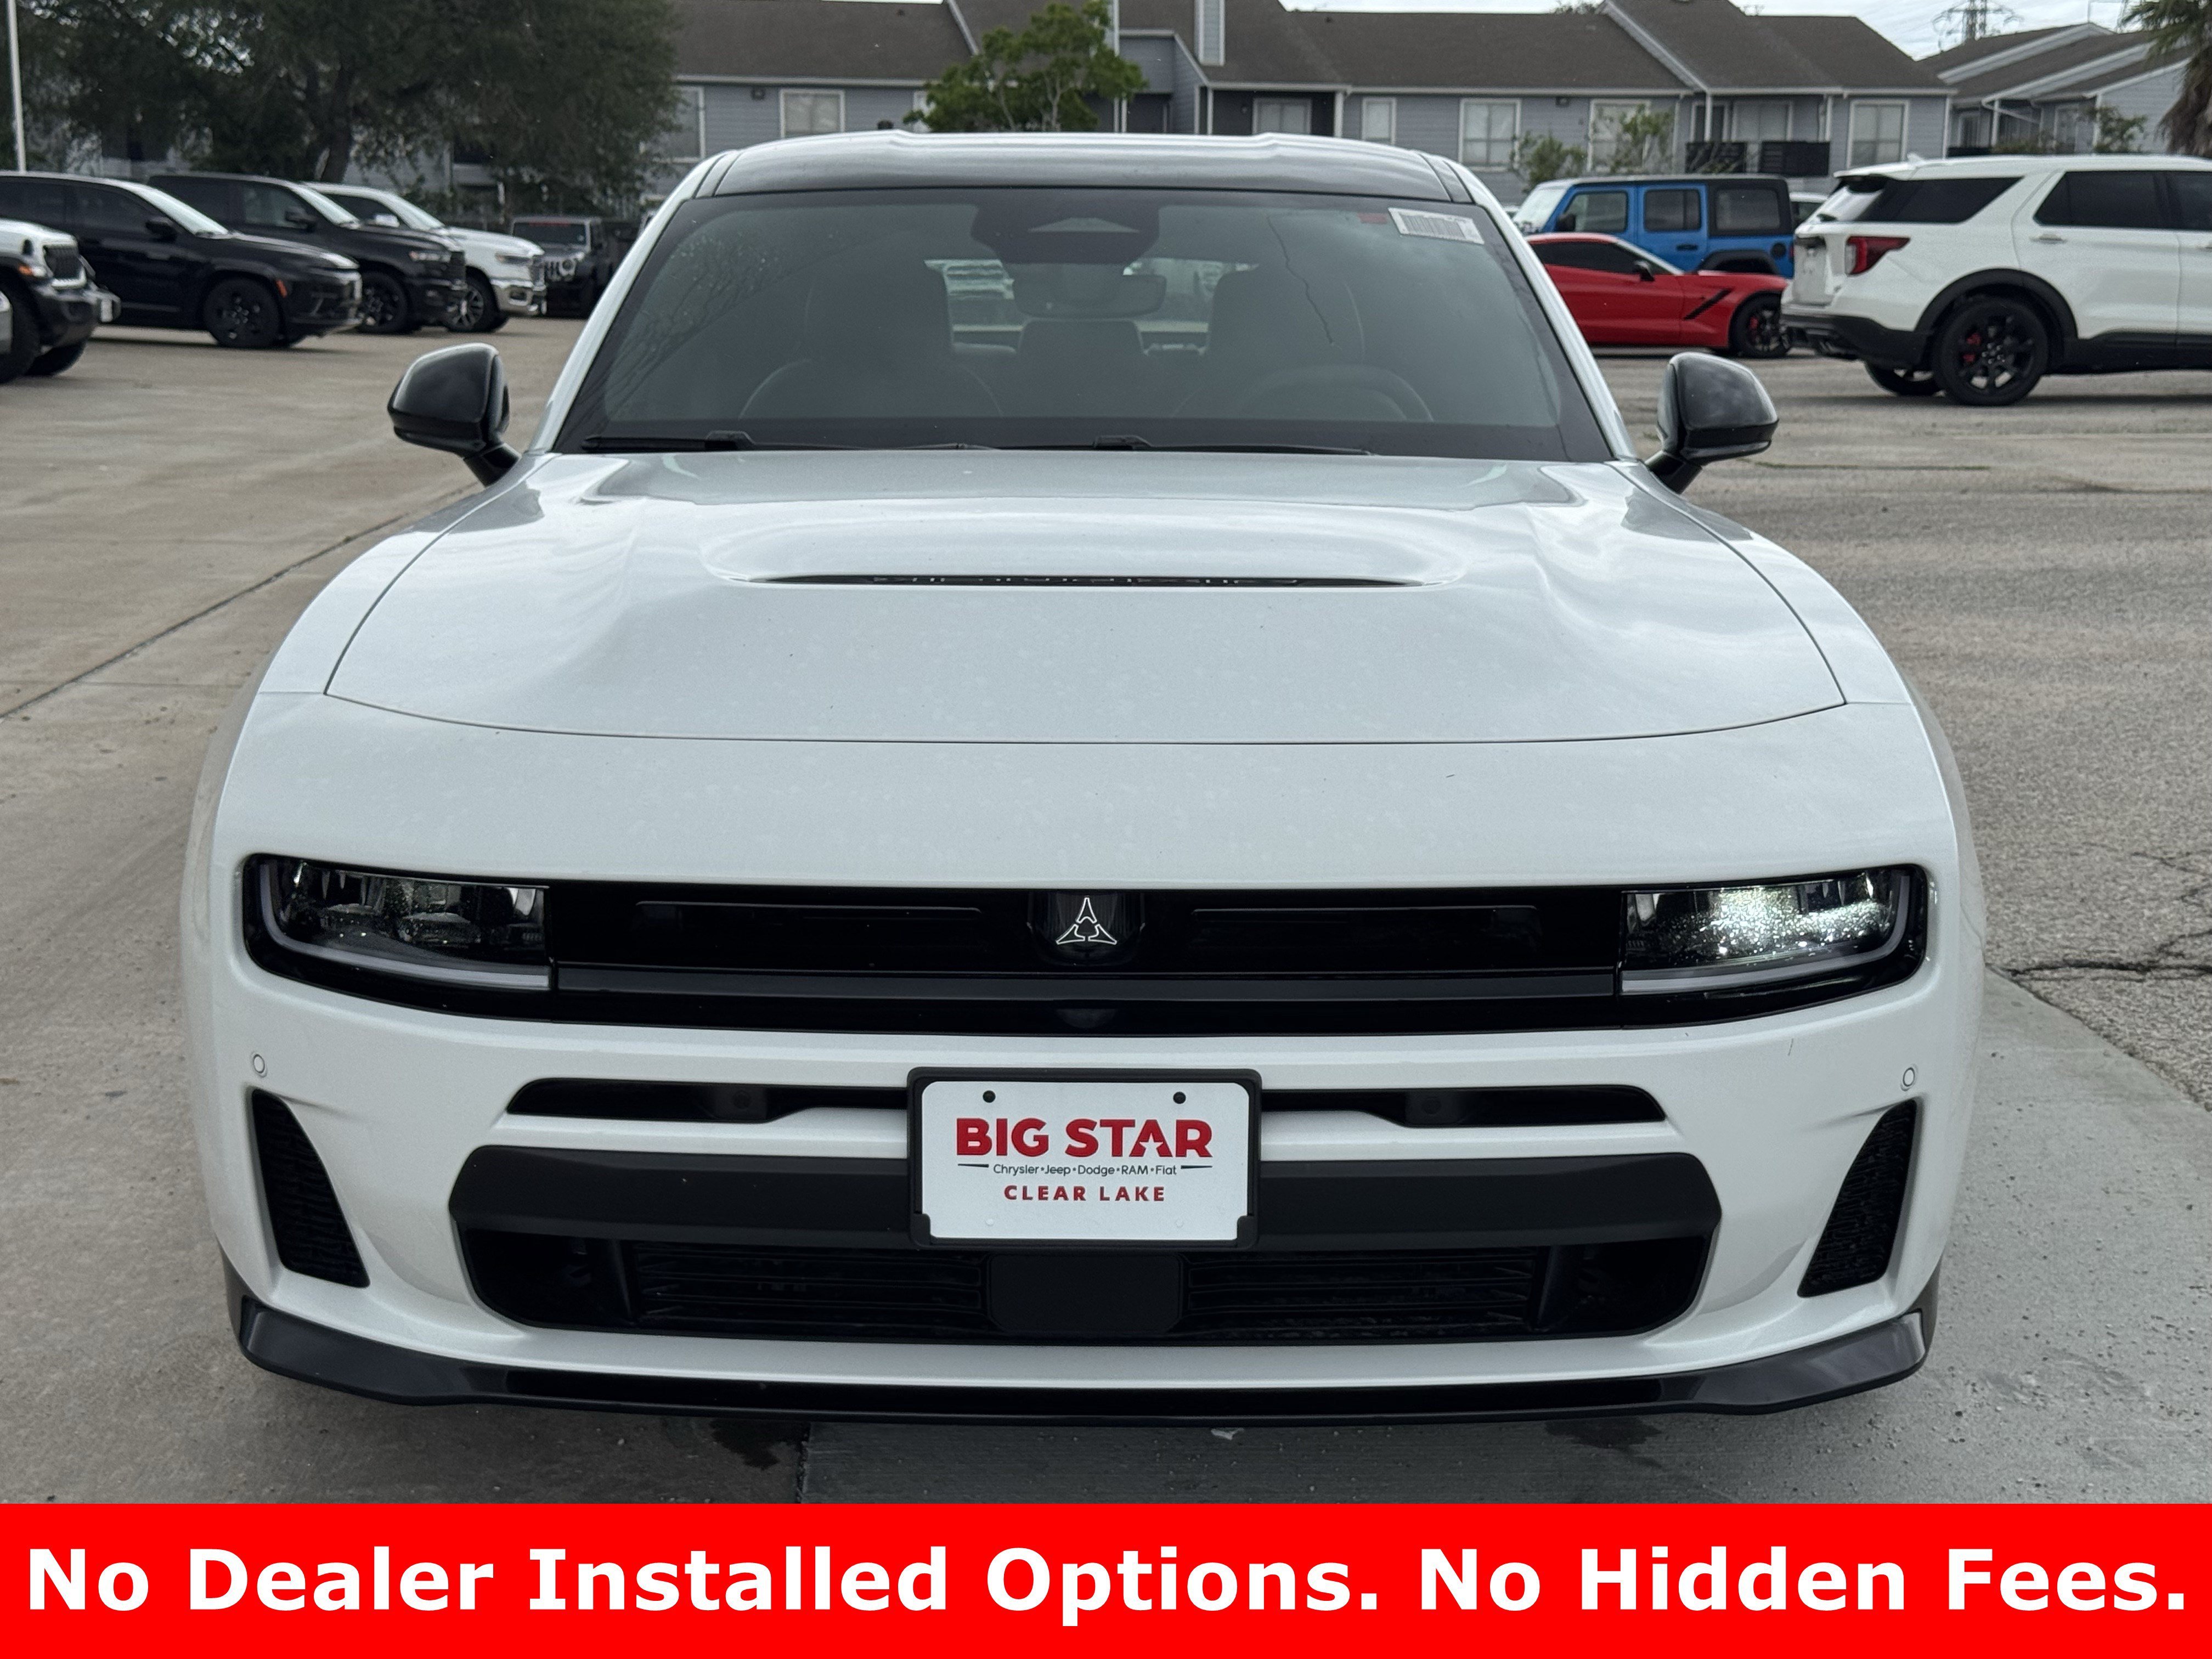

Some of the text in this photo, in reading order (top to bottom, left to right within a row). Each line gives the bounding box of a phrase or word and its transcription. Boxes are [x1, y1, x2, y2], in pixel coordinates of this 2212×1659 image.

[956, 1118, 1213, 1158] BIG STAR
[993, 1164, 1177, 1177] Chrysler Jeep Dodge RAM Fiat
[1004, 1185, 1165, 1202] CLEAR LAKE
